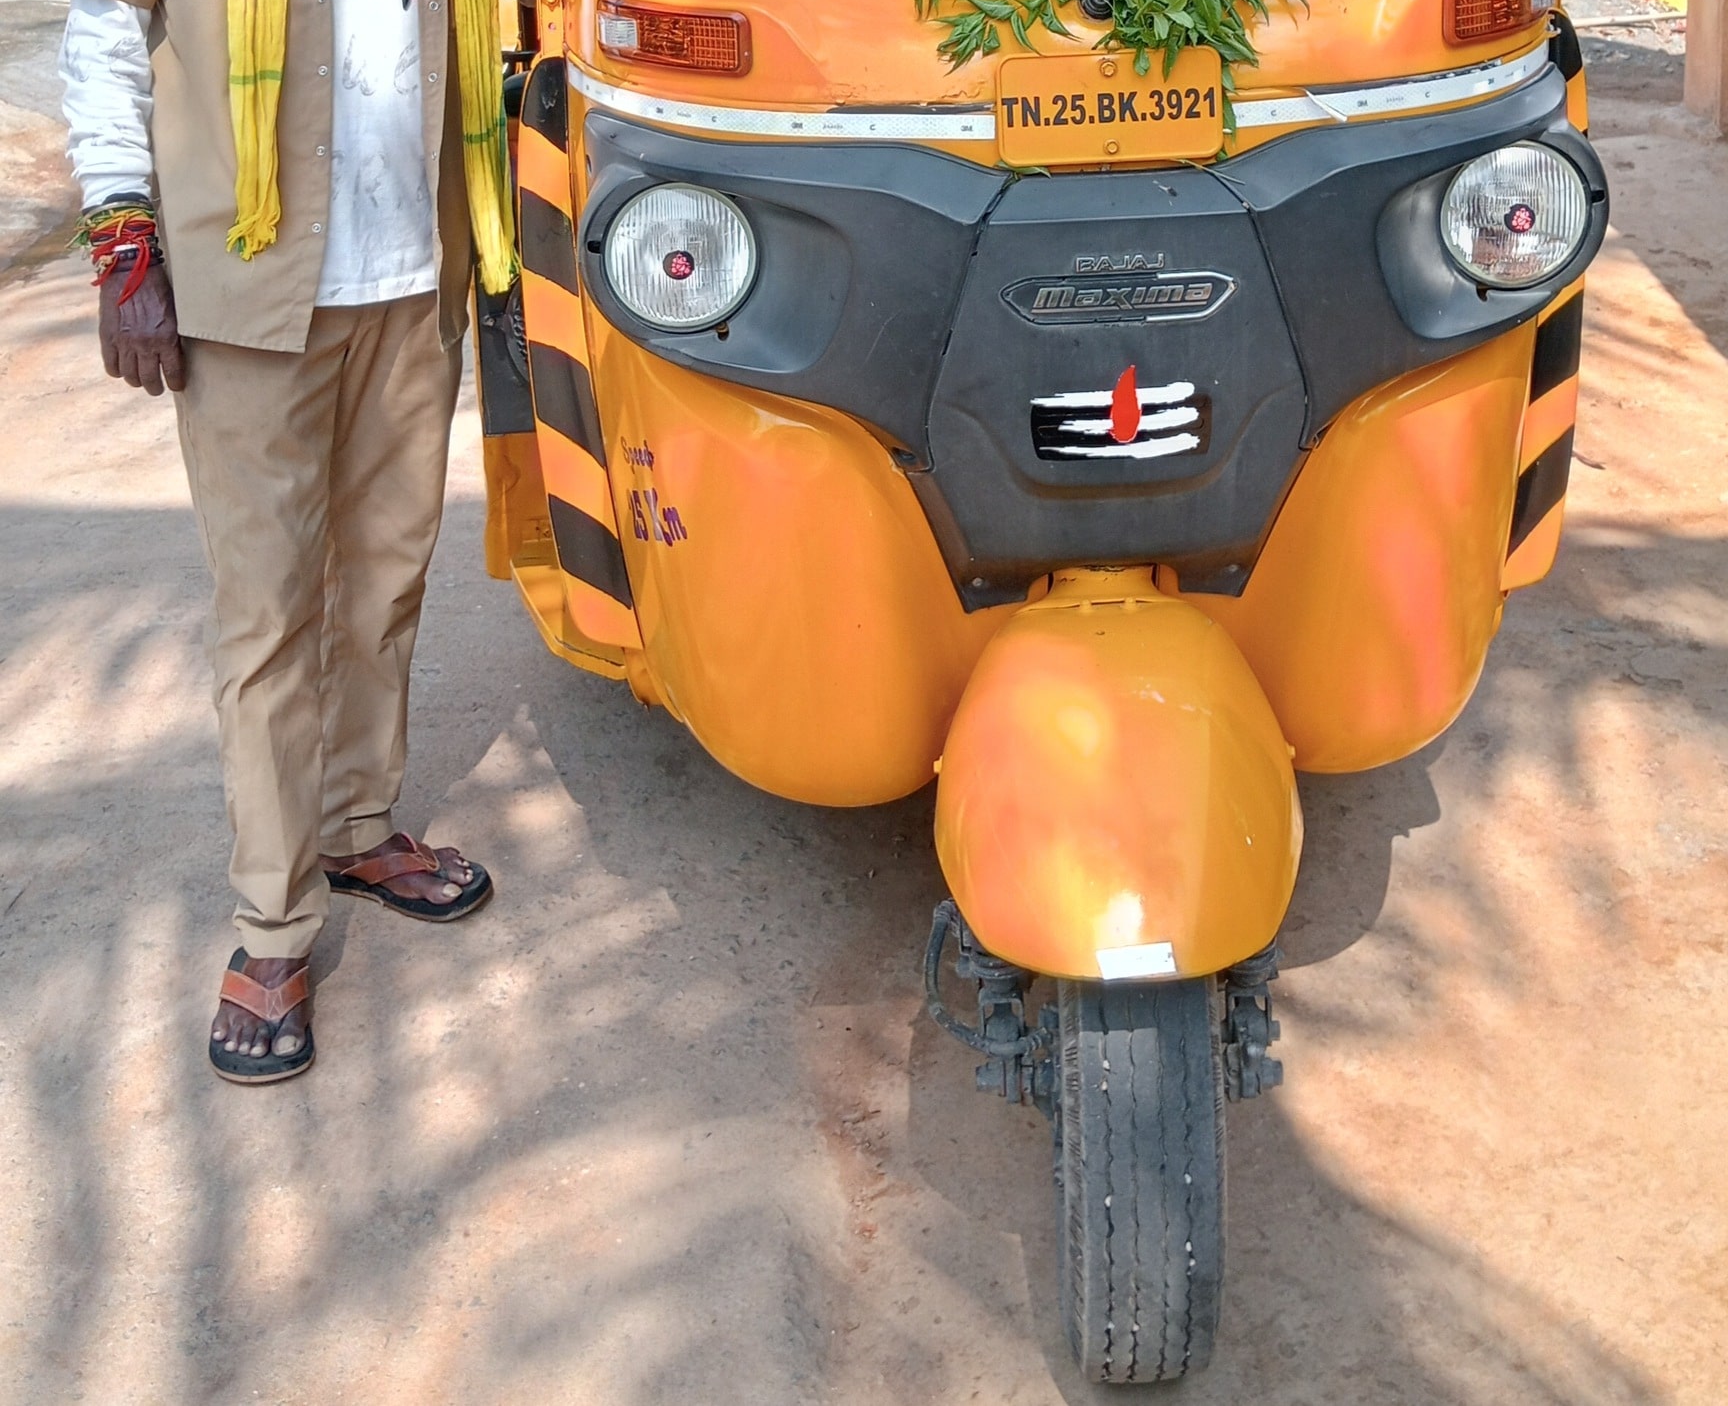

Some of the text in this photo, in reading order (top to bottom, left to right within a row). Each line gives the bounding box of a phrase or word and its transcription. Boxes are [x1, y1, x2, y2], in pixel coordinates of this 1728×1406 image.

[1001, 87, 1216, 128] TN.25.BK.3921
[1075, 253, 1165, 273] BAJAJ
[1031, 282, 1213, 311] Maxima
